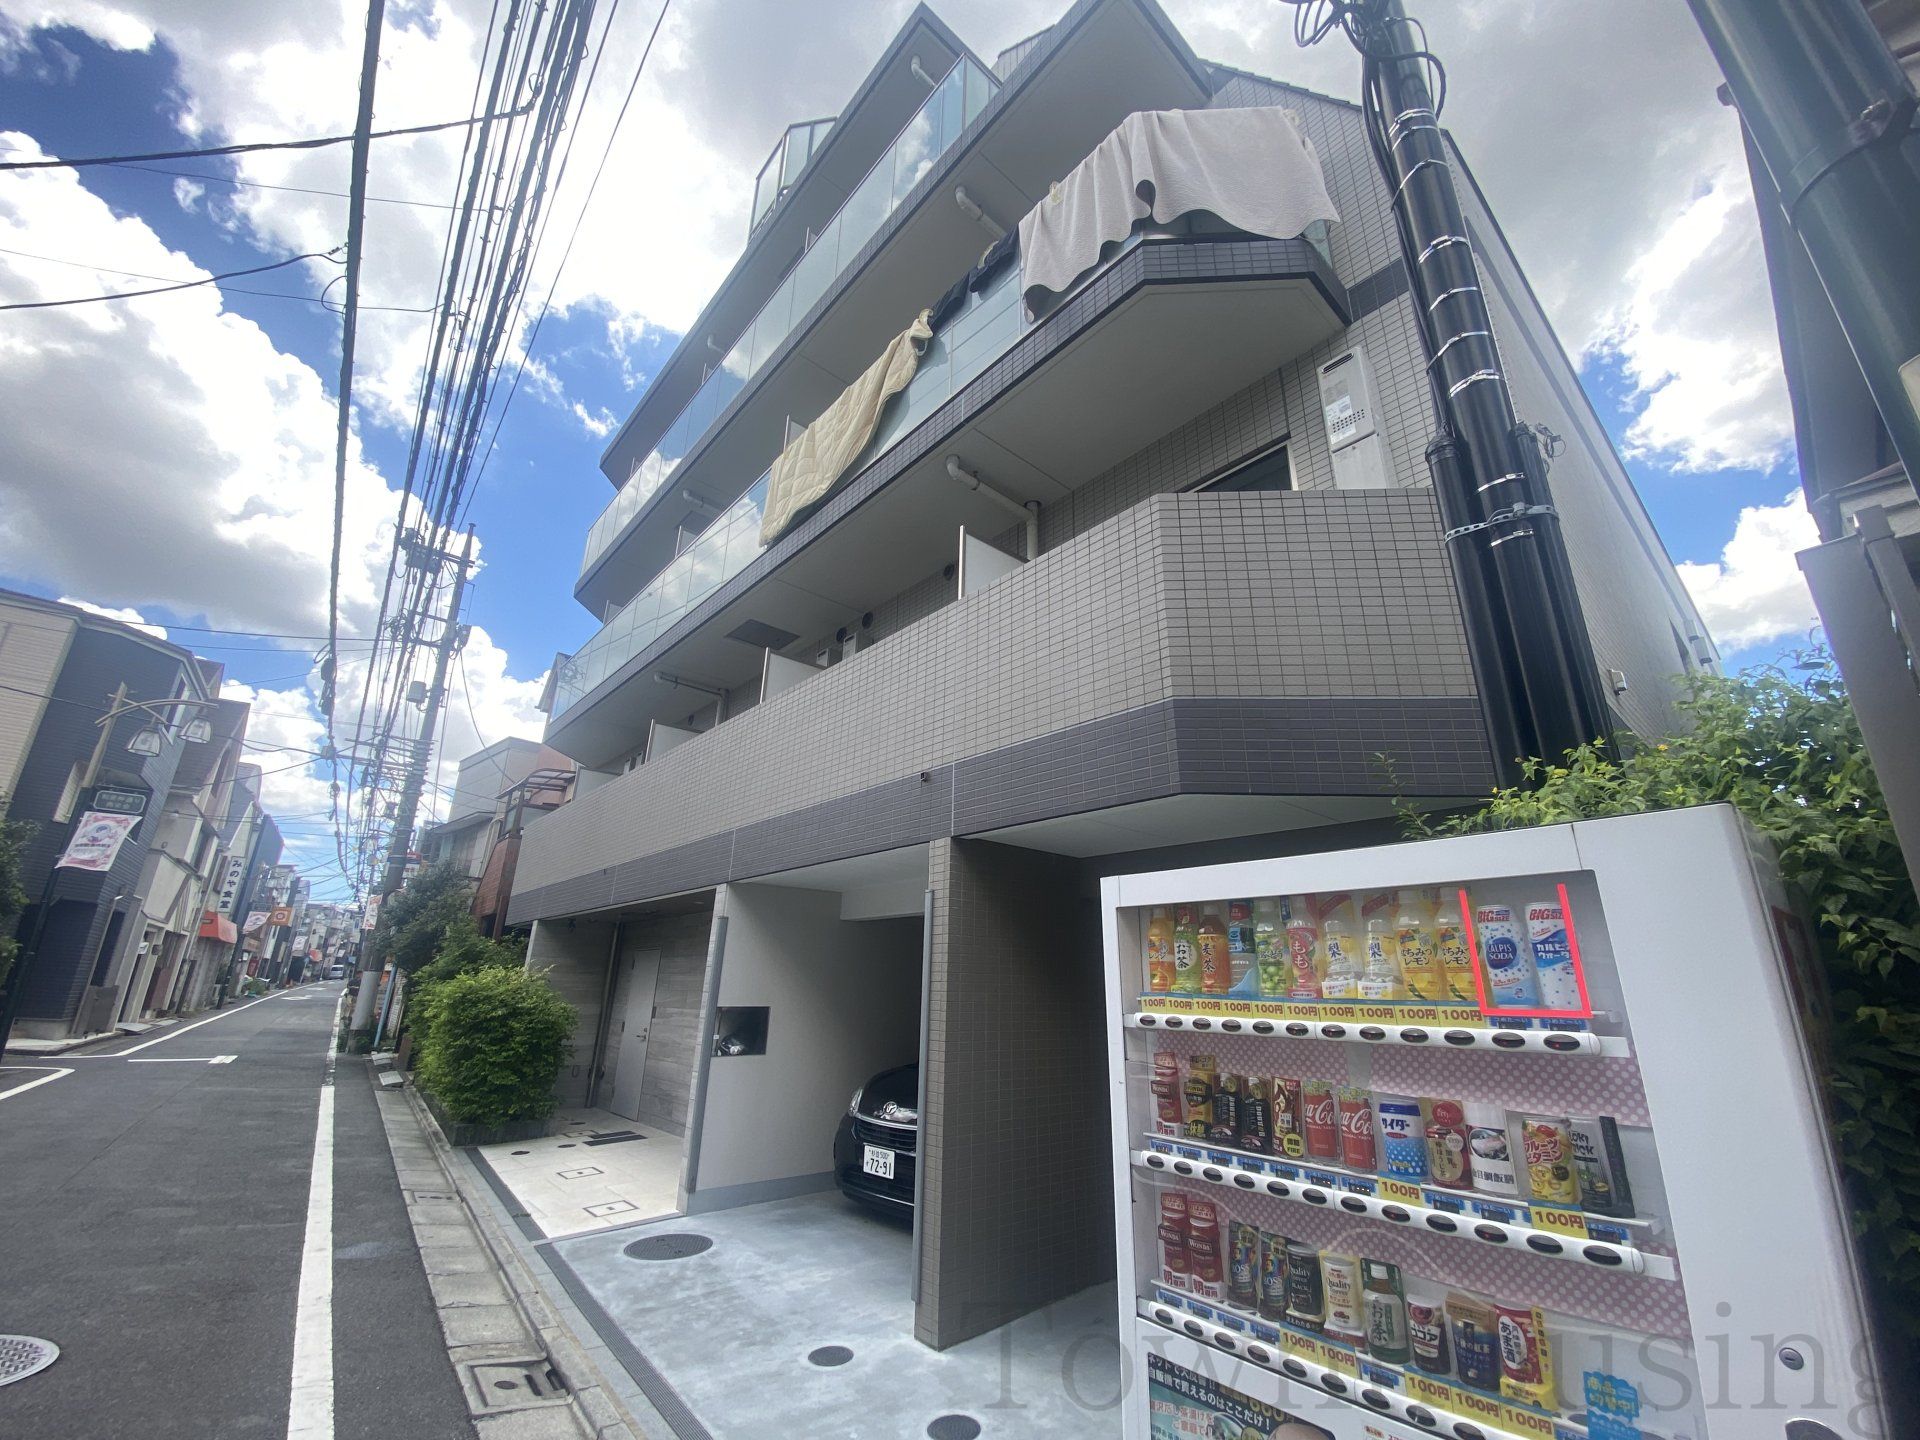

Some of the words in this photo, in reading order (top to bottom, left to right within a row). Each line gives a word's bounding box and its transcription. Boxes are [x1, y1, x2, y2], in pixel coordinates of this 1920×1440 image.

[218, 860, 242, 909] みのや食堂
[1477, 909, 1494, 923] BIG
[1530, 908, 1550, 921] BIG
[1292, 941, 1308, 968] もも
[1536, 944, 1568, 952] カルピ
[1176, 943, 1190, 969] お茶
[1201, 943, 1216, 973] 麦茶
[1404, 957, 1430, 966] レモン
[1489, 952, 1513, 961] SODA
[1538, 951, 1570, 960] ウォータ
[1144, 998, 1165, 1007] 100円
[1169, 1000, 1192, 1010] 100円
[1196, 1001, 1220, 1010] 100円
[1225, 1003, 1250, 1013] 100円
[1255, 1004, 1283, 1014] 100円
[1287, 1006, 1318, 1016] 100円
[1322, 1006, 1355, 1017] 100円
[1359, 1007, 1394, 1019] 100円
[1399, 1008, 1437, 1020] 100円
[1442, 1009, 1482, 1022] 100円
[1524, 1138, 1559, 1151] フルーツ
[870, 1158, 892, 1177] 72-91
[1382, 1180, 1420, 1199] 100円
[1535, 1210, 1583, 1229] 100円
[1189, 1239, 1211, 1251] WONDA
[1411, 1328, 1438, 1342] ココア
[1283, 1332, 1316, 1353] 100円
[1500, 1321, 1516, 1363] あま酒
[1320, 1345, 1355, 1367] 100円
[1409, 1376, 1449, 1400] 100円
[1455, 1392, 1500, 1418] 100円
[1506, 1409, 1553, 1435] 100円
